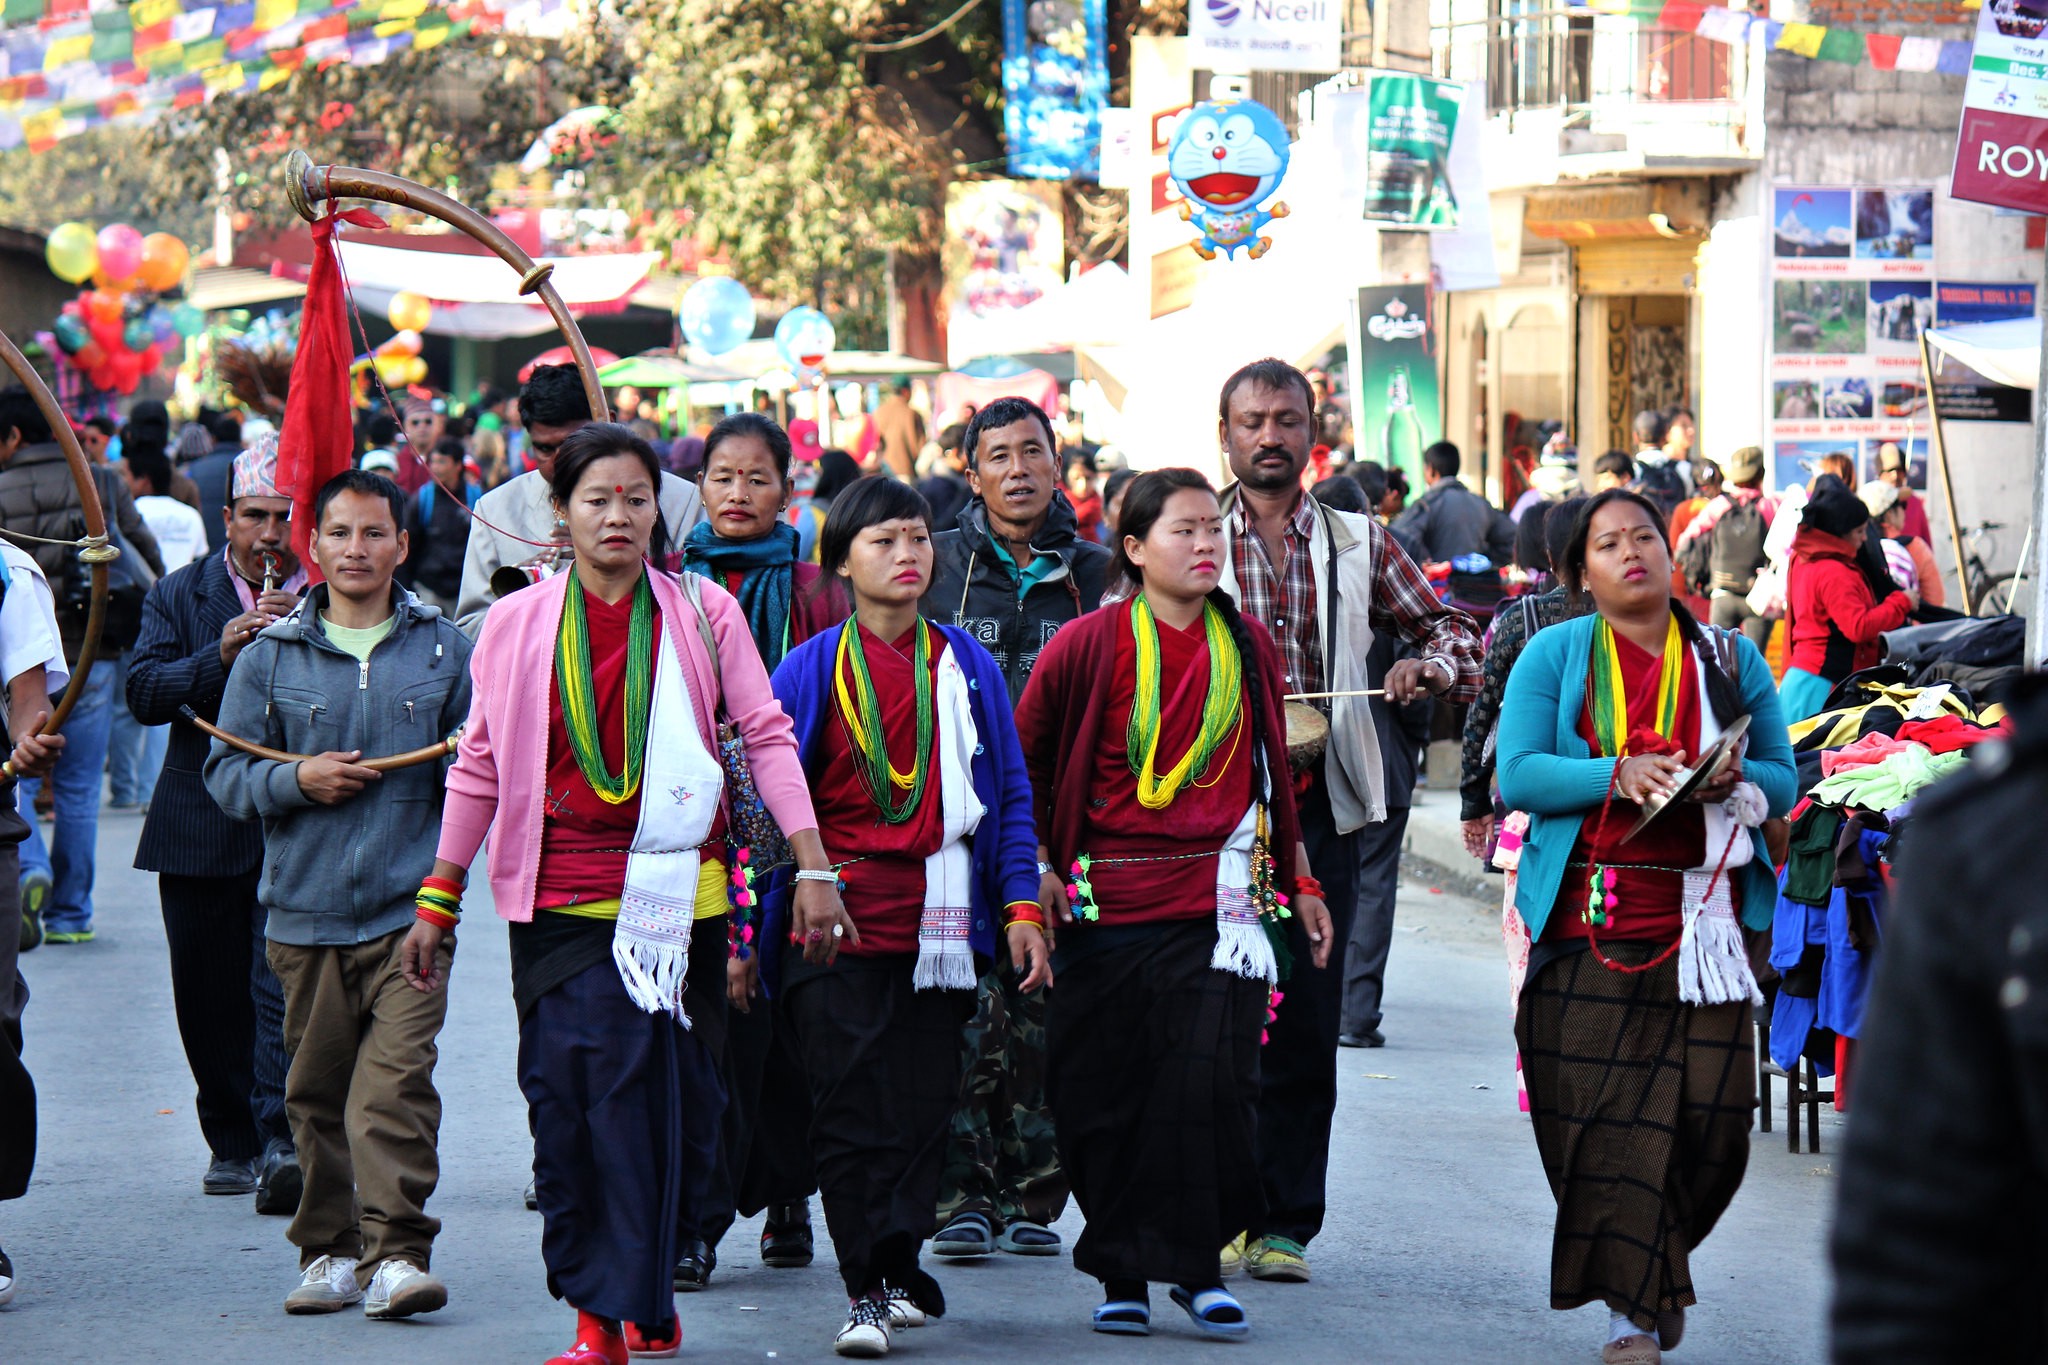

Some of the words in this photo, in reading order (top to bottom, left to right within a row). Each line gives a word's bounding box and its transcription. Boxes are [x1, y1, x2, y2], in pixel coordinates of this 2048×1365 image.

[1253, 0, 1325, 21] Ncell
[2009, 62, 2039, 78] Dec.
[1978, 140, 2048, 182] ROY
